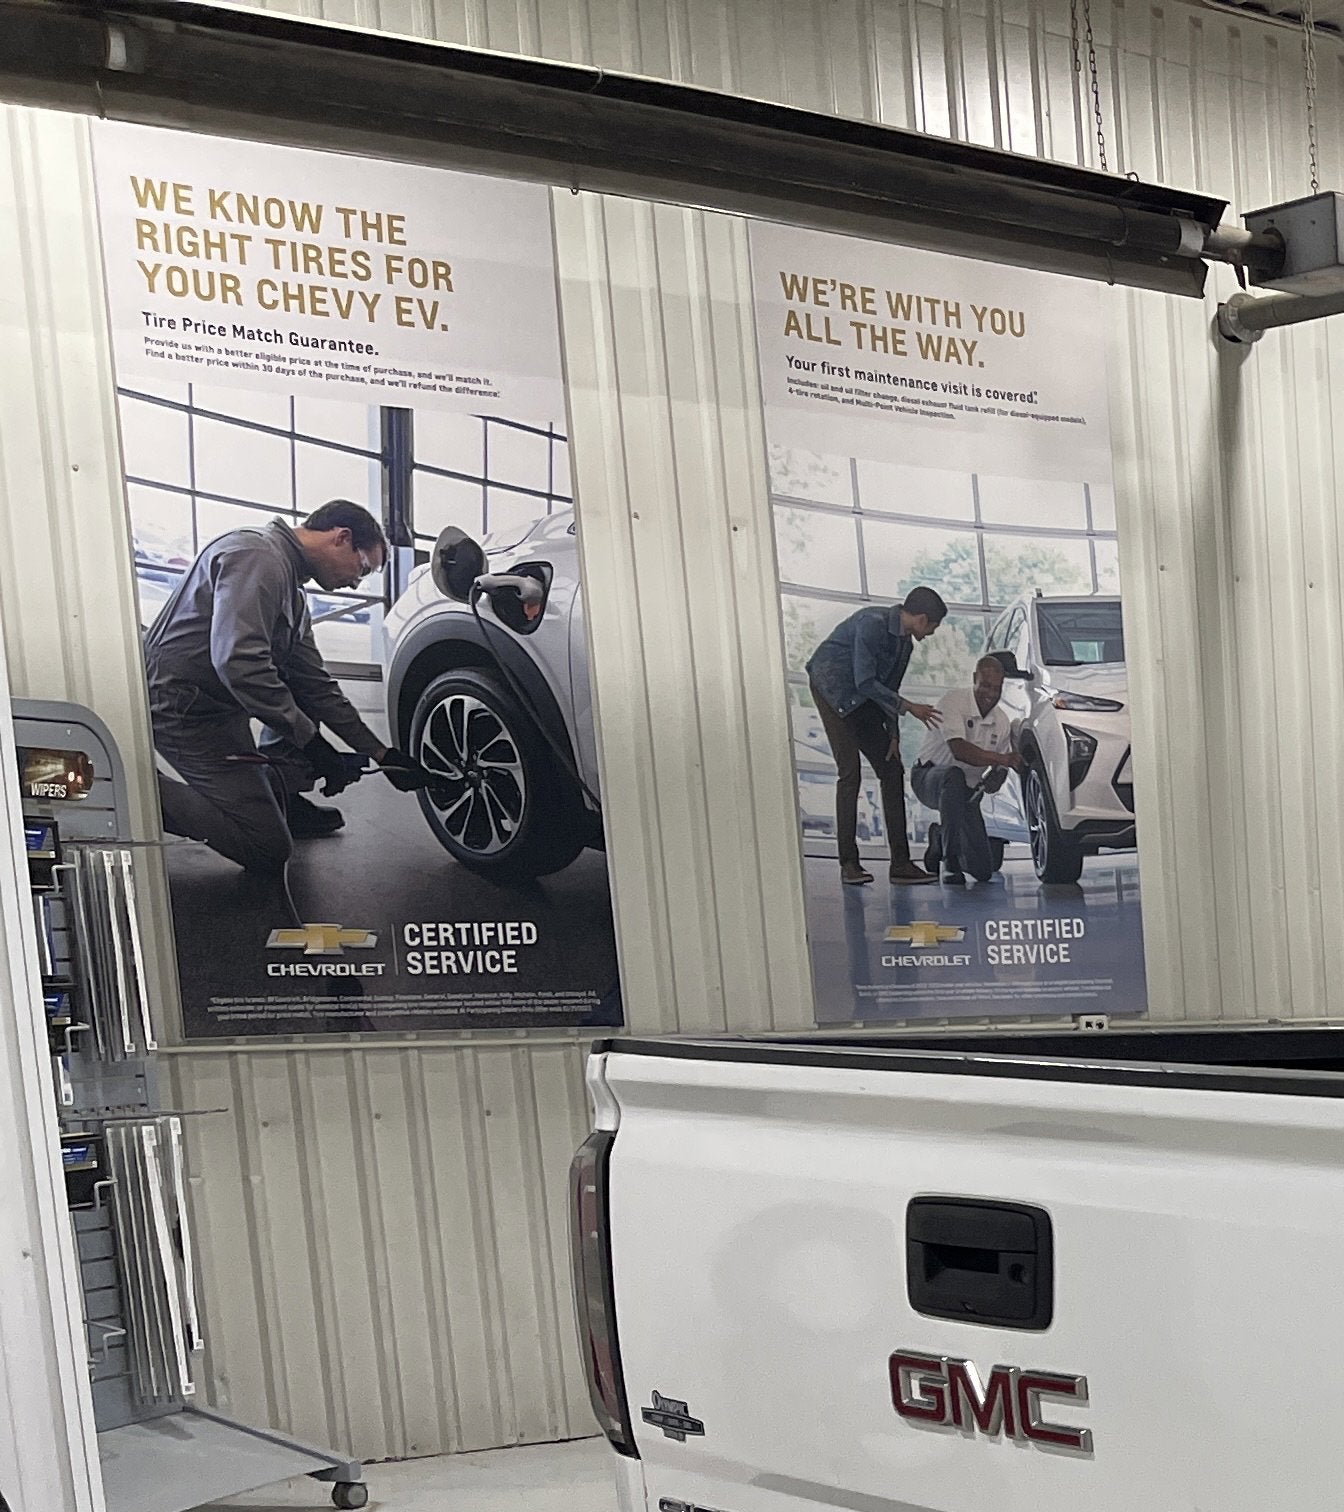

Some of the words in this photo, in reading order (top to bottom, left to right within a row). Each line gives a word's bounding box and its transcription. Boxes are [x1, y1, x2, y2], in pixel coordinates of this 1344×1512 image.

[130, 176, 194, 216] WE
[208, 189, 323, 234] KNOW
[335, 207, 407, 246] THE
[135, 218, 252, 265] RIGHT
[264, 238, 372, 282] TIRES
[384, 253, 454, 292] FOR
[136, 260, 243, 306] YOUR
[256, 278, 382, 323] CHEVY
[395, 296, 449, 331] EV.
[780, 272, 877, 316] WE'RE
[886, 290, 961, 328] WITH
[970, 304, 1025, 338] YOU
[142, 311, 176, 330] Tire
[182, 317, 226, 336] Price
[232, 324, 283, 344] Match
[289, 332, 379, 355] Guarantee.
[785, 310, 842, 346] ALL
[850, 321, 907, 356] THE
[916, 332, 984, 368] WAY.
[144, 336, 178, 349] Provide
[181, 343, 193, 351] us
[195, 344, 214, 354] with
[225, 347, 252, 359] better
[289, 356, 311, 368] price
[325, 360, 338, 369] the
[341, 362, 360, 372] time
[417, 371, 432, 380] and
[456, 375, 481, 386] match
[146, 349, 165, 359] Find
[175, 352, 203, 364] better
[206, 357, 229, 368] price
[232, 361, 259, 371] within
[275, 365, 295, 377] days
[309, 370, 322, 379] the
[370, 377, 385, 386] and
[409, 380, 436, 391] refund
[439, 385, 452, 393] the
[786, 355, 816, 372] Your
[821, 362, 850, 379] first
[855, 369, 938, 392] maintenance
[941, 381, 968, 396] visit
[972, 386, 981, 398] is
[31, 783, 67, 798] WIPERS
[404, 922, 538, 947] CERTIFIED
[985, 918, 1084, 940] CERTIFIED
[267, 963, 386, 977] CHEVROLET
[406, 950, 518, 975] SERVICE
[881, 955, 971, 967] CHEVROLET
[987, 944, 1070, 965] SERVICE
[889, 1349, 1094, 1453] GMC
